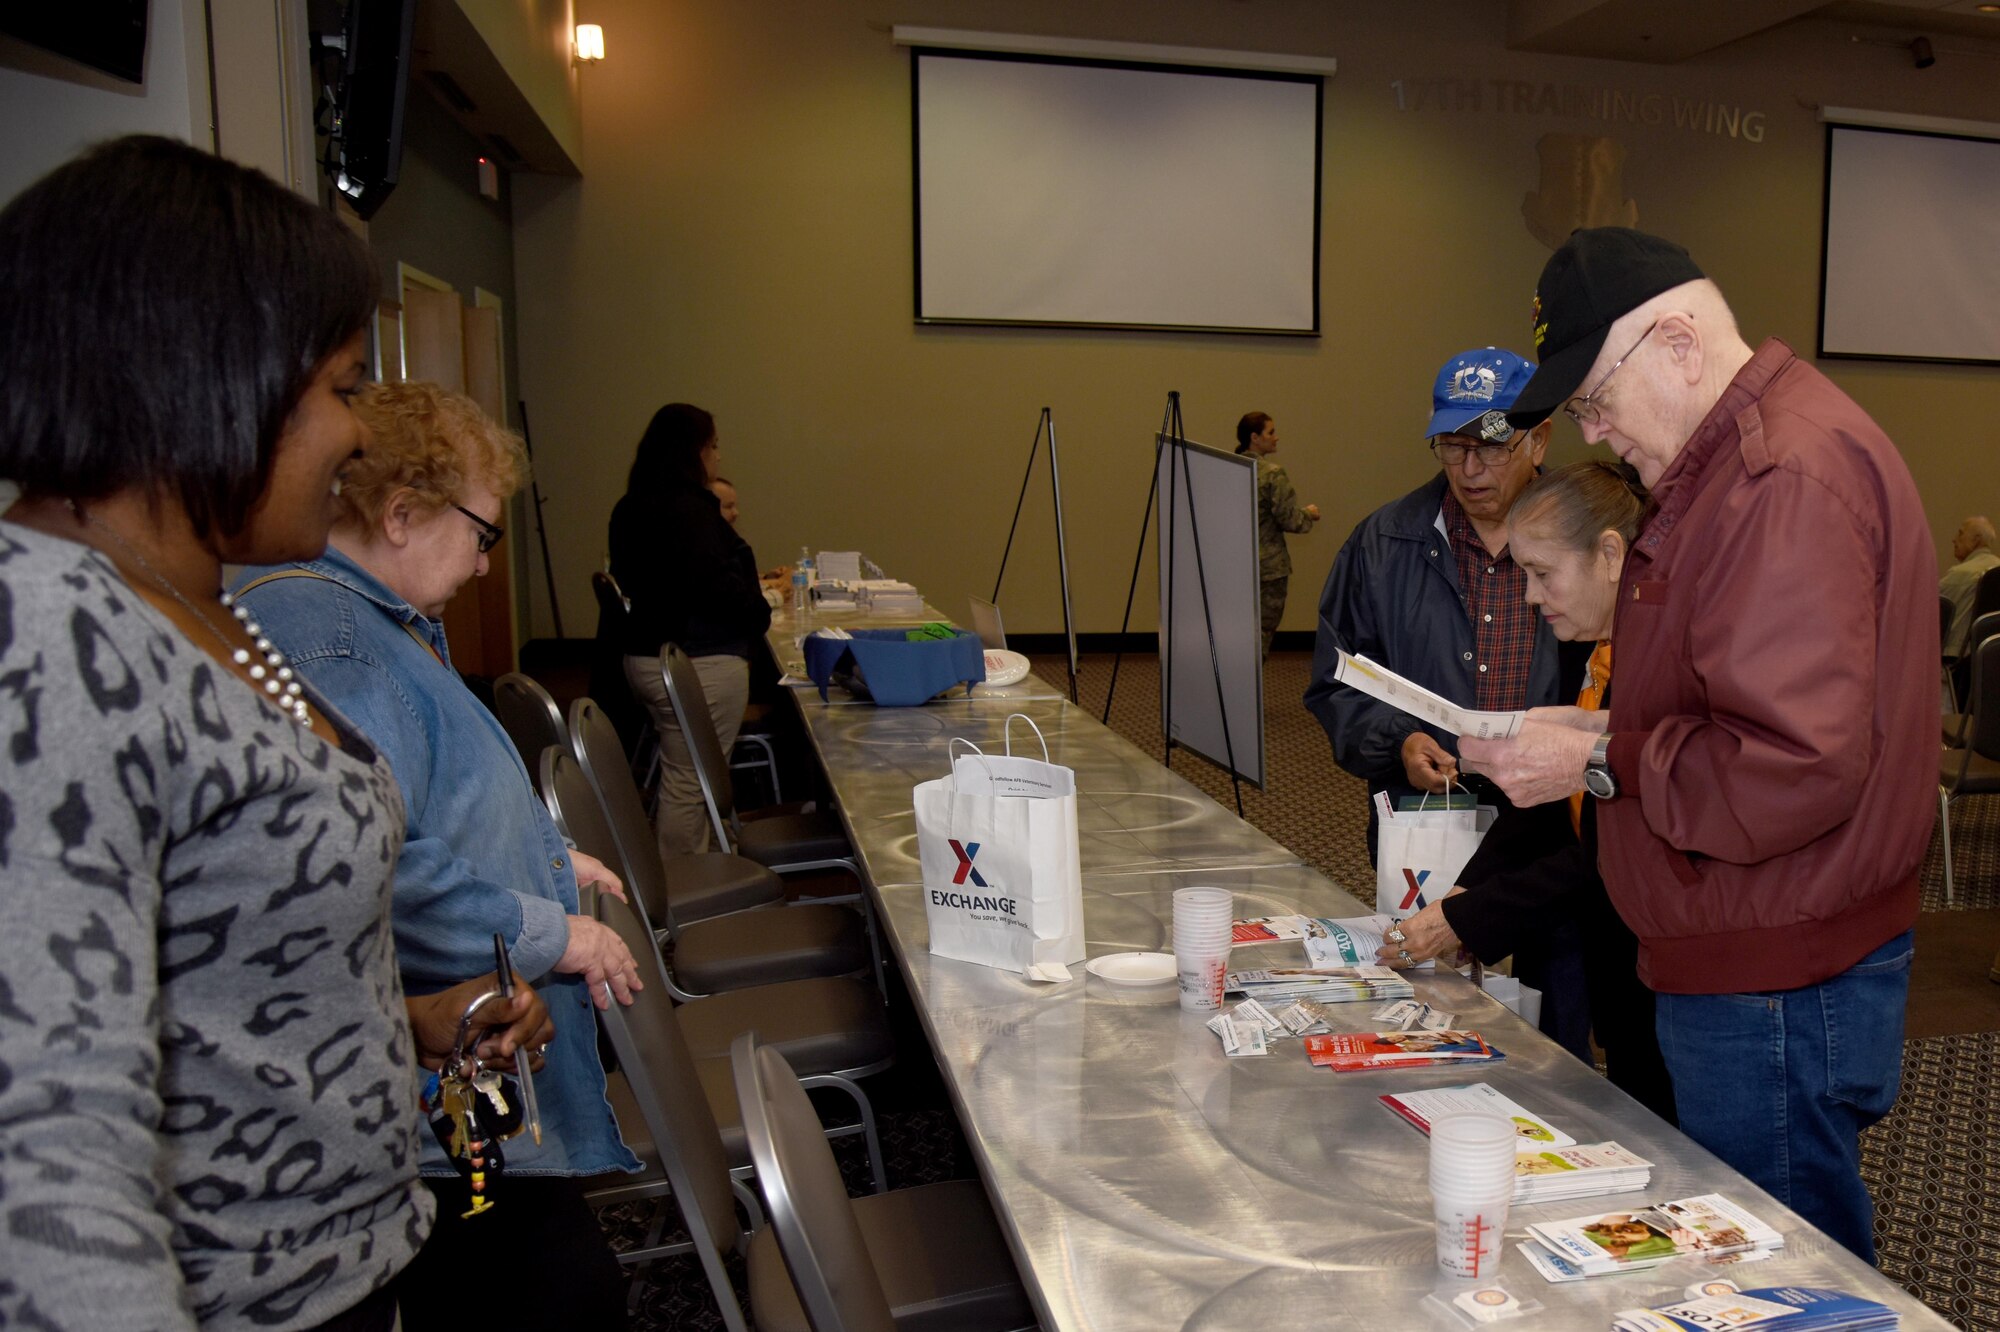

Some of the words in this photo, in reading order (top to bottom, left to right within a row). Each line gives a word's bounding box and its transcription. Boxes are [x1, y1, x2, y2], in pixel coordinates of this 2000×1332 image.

[1390, 79, 1483, 113] 17TH
[1487, 79, 1665, 126] TRAINING
[1670, 93, 1766, 144] WING
[1480, 425, 1498, 441] AIR
[931, 890, 1016, 916] EXCHANGE
[982, 914, 998, 922] save,
[1558, 1237, 1593, 1257] EASY
[1545, 1254, 1579, 1276] EASY
[1665, 1307, 1733, 1330] LOST
